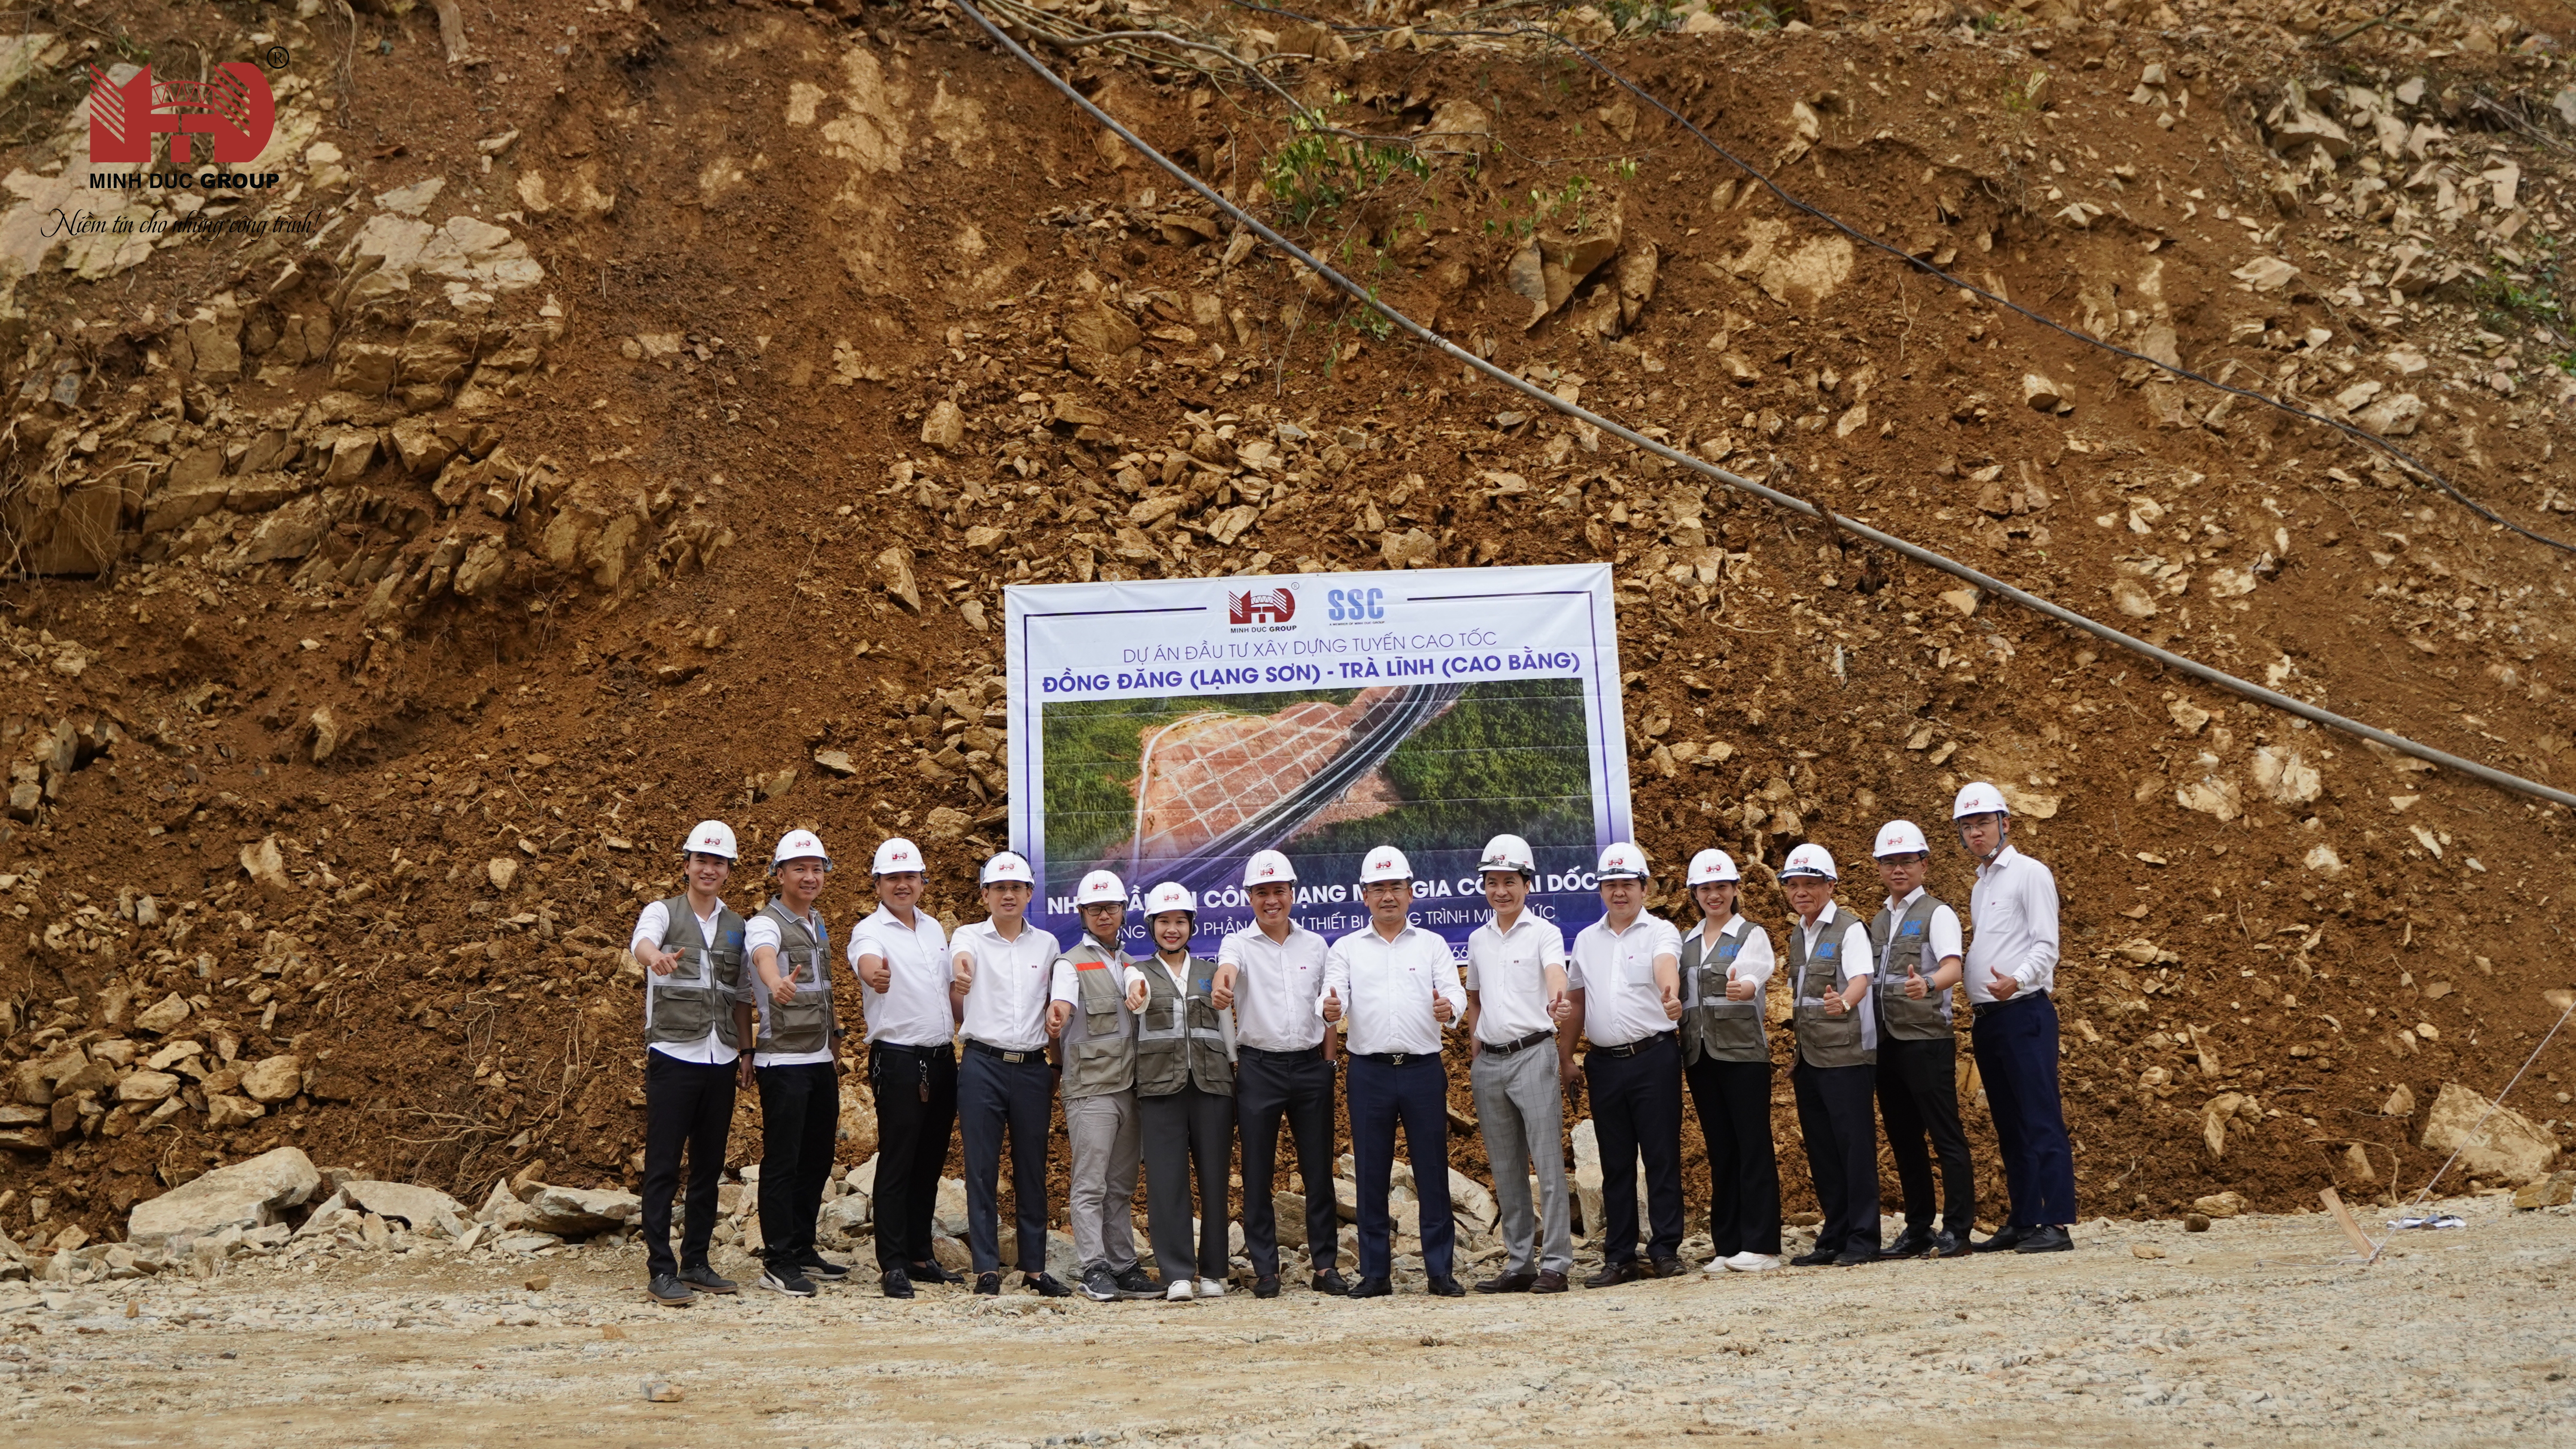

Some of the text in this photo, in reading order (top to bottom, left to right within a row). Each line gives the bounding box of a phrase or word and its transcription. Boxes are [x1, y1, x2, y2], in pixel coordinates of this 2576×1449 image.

[1327, 588, 1384, 621] SSC
[1124, 628, 1497, 665] DỰ ÁN ĐẦU TƯ XÂY DỰNG TUYẾN CAO TỐC
[1042, 668, 1110, 693] ĐỒNG
[1117, 668, 1182, 690] ĐĂNG
[1190, 666, 1259, 690] (LẠNG
[1266, 663, 1321, 685] SƠN)
[1339, 656, 1380, 679] TRÀ
[1386, 656, 1434, 677] LĨNH
[1441, 655, 1501, 679] (CAO
[1508, 646, 1580, 673] BẰNG)
[1411, 879, 1452, 899] GIA
[1547, 865, 1599, 892] DỐC
[1047, 896, 1079, 914] NH
[1203, 884, 1251, 908] CÔN
[1308, 911, 1347, 930] THIẾT
[1425, 907, 1469, 925] TRÌNH
